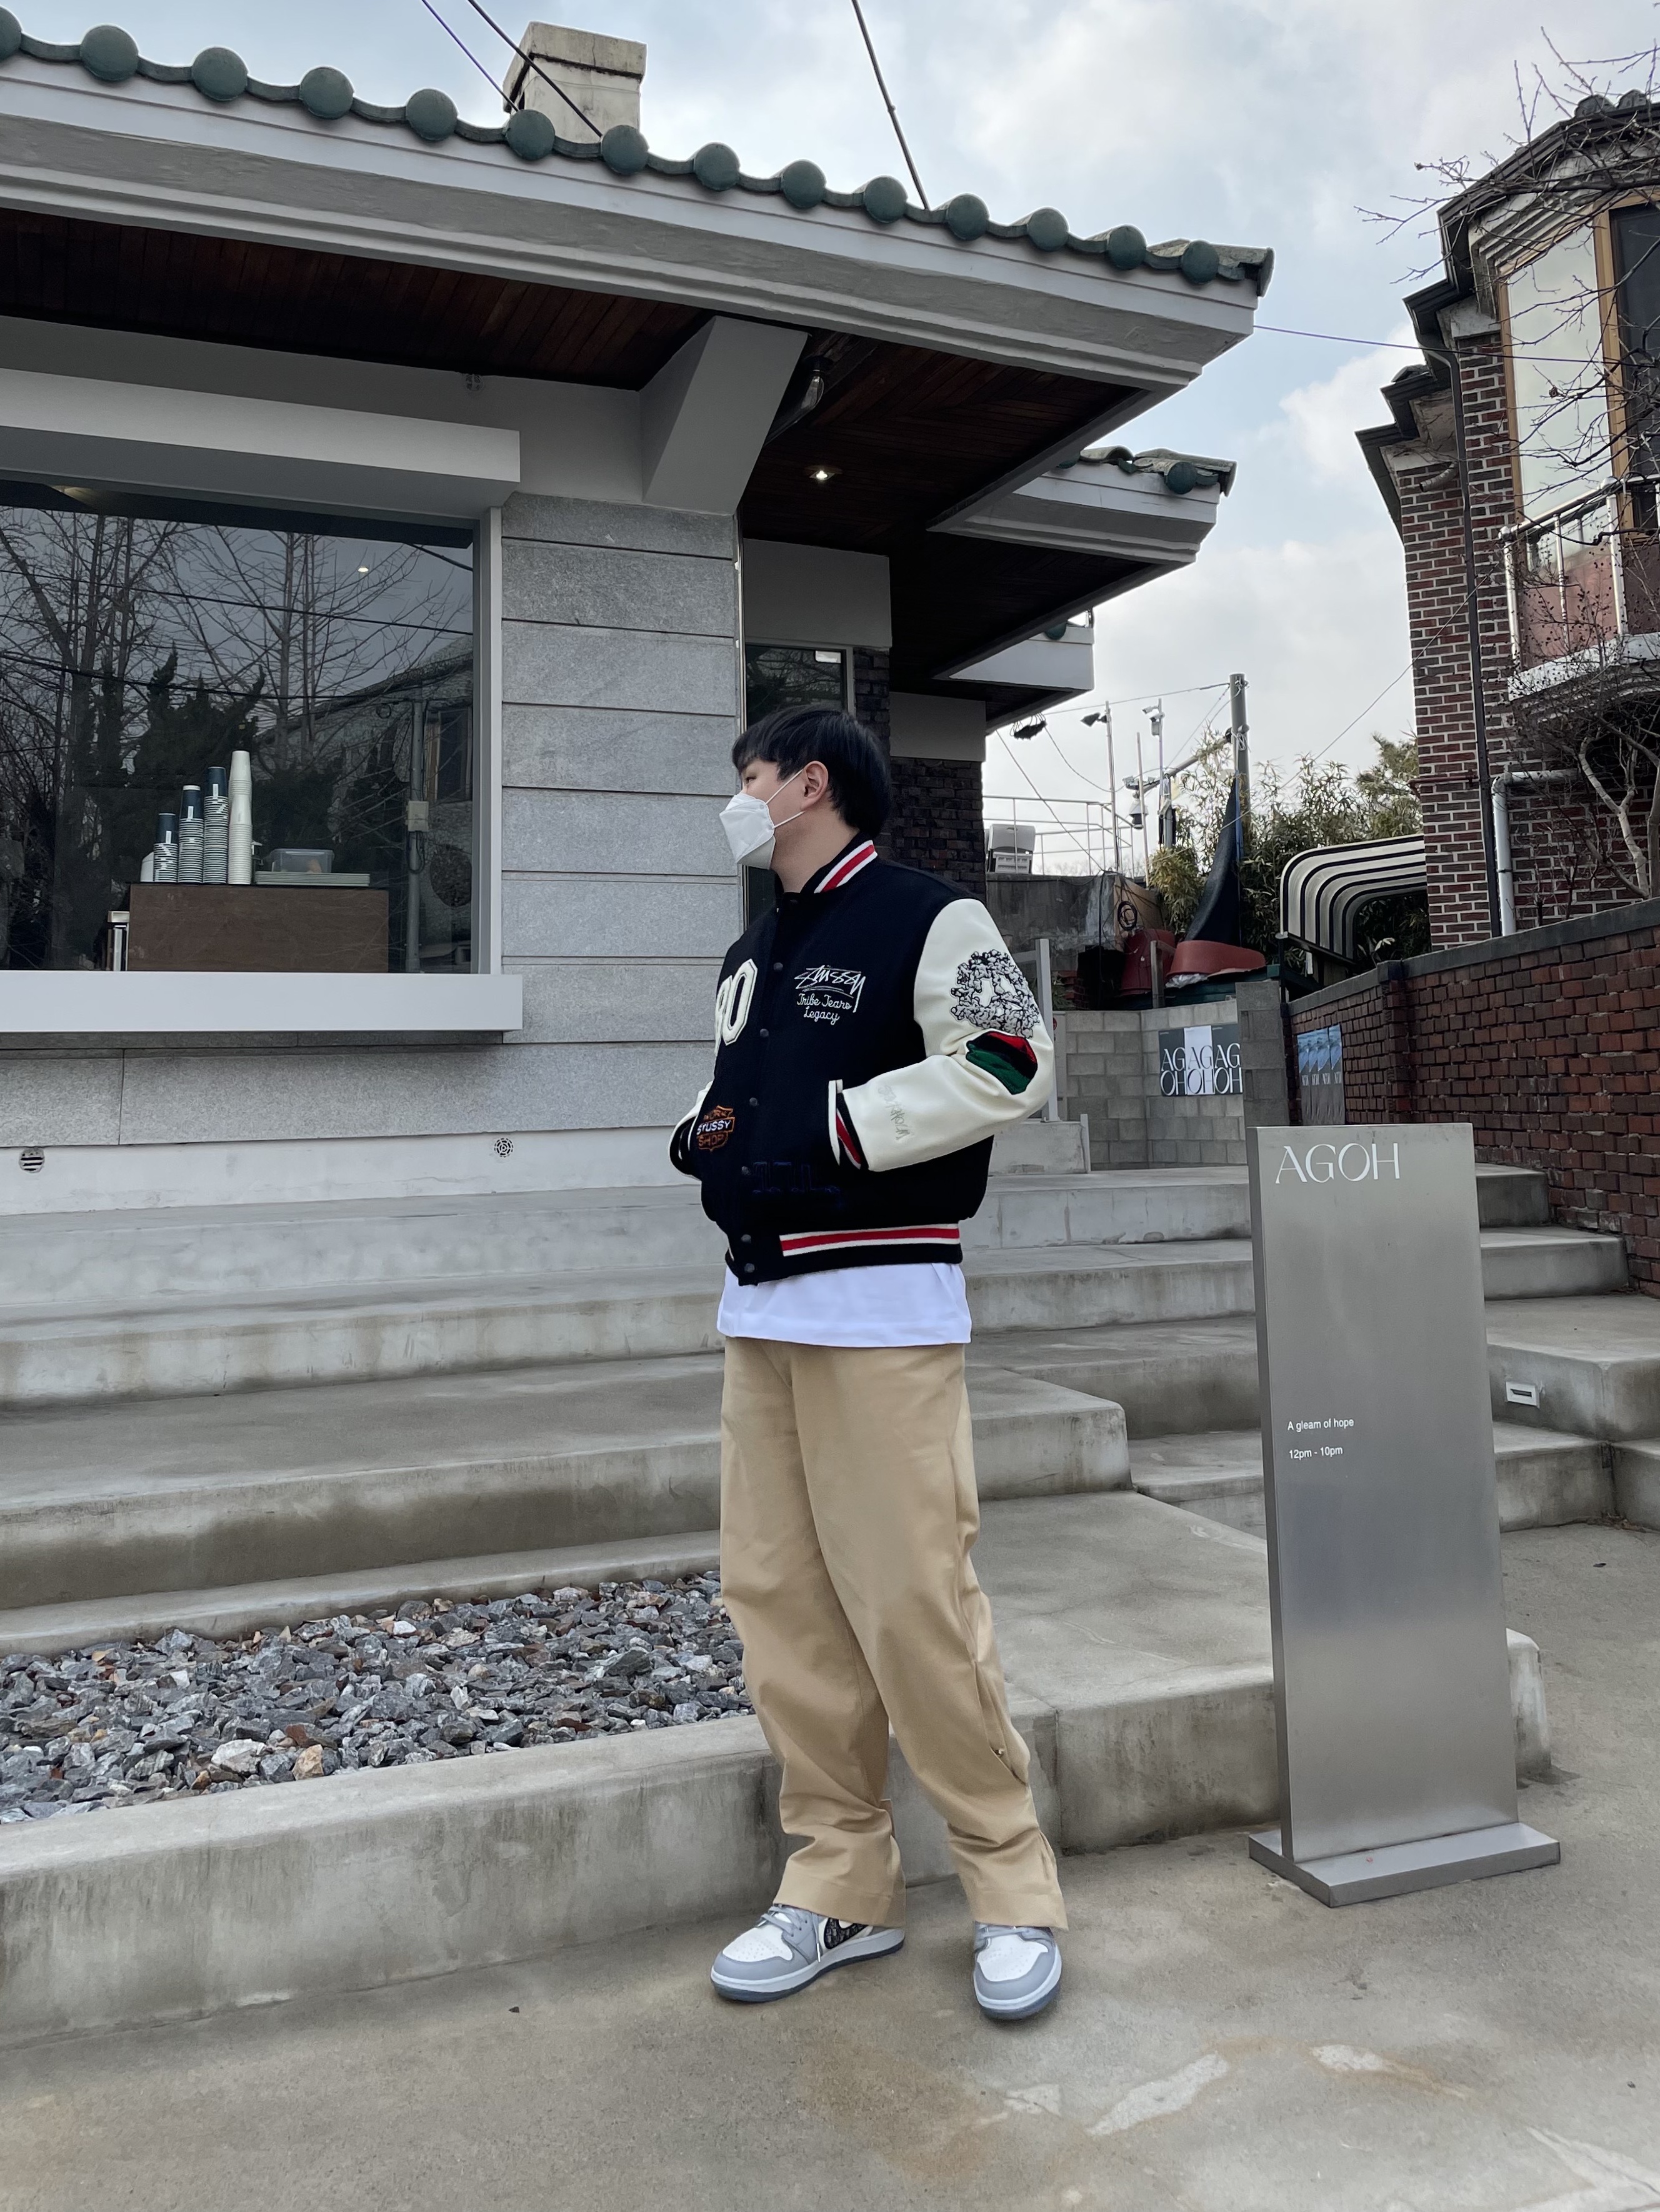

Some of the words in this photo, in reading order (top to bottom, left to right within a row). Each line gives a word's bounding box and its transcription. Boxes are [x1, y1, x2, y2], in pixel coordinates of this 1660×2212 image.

[797, 994, 821, 1005] Tribe
[804, 1006, 840, 1025] Legacy
[696, 1120, 731, 1135] STUSSY
[1275, 1143, 1400, 1184] AGOH
[1288, 1421, 1294, 1430] A
[1296, 1420, 1321, 1432] gleam
[1323, 1418, 1331, 1428] of
[1333, 1418, 1354, 1429] hope
[1289, 1449, 1312, 1460] 12pm
[1320, 1446, 1343, 1457] 10pm
